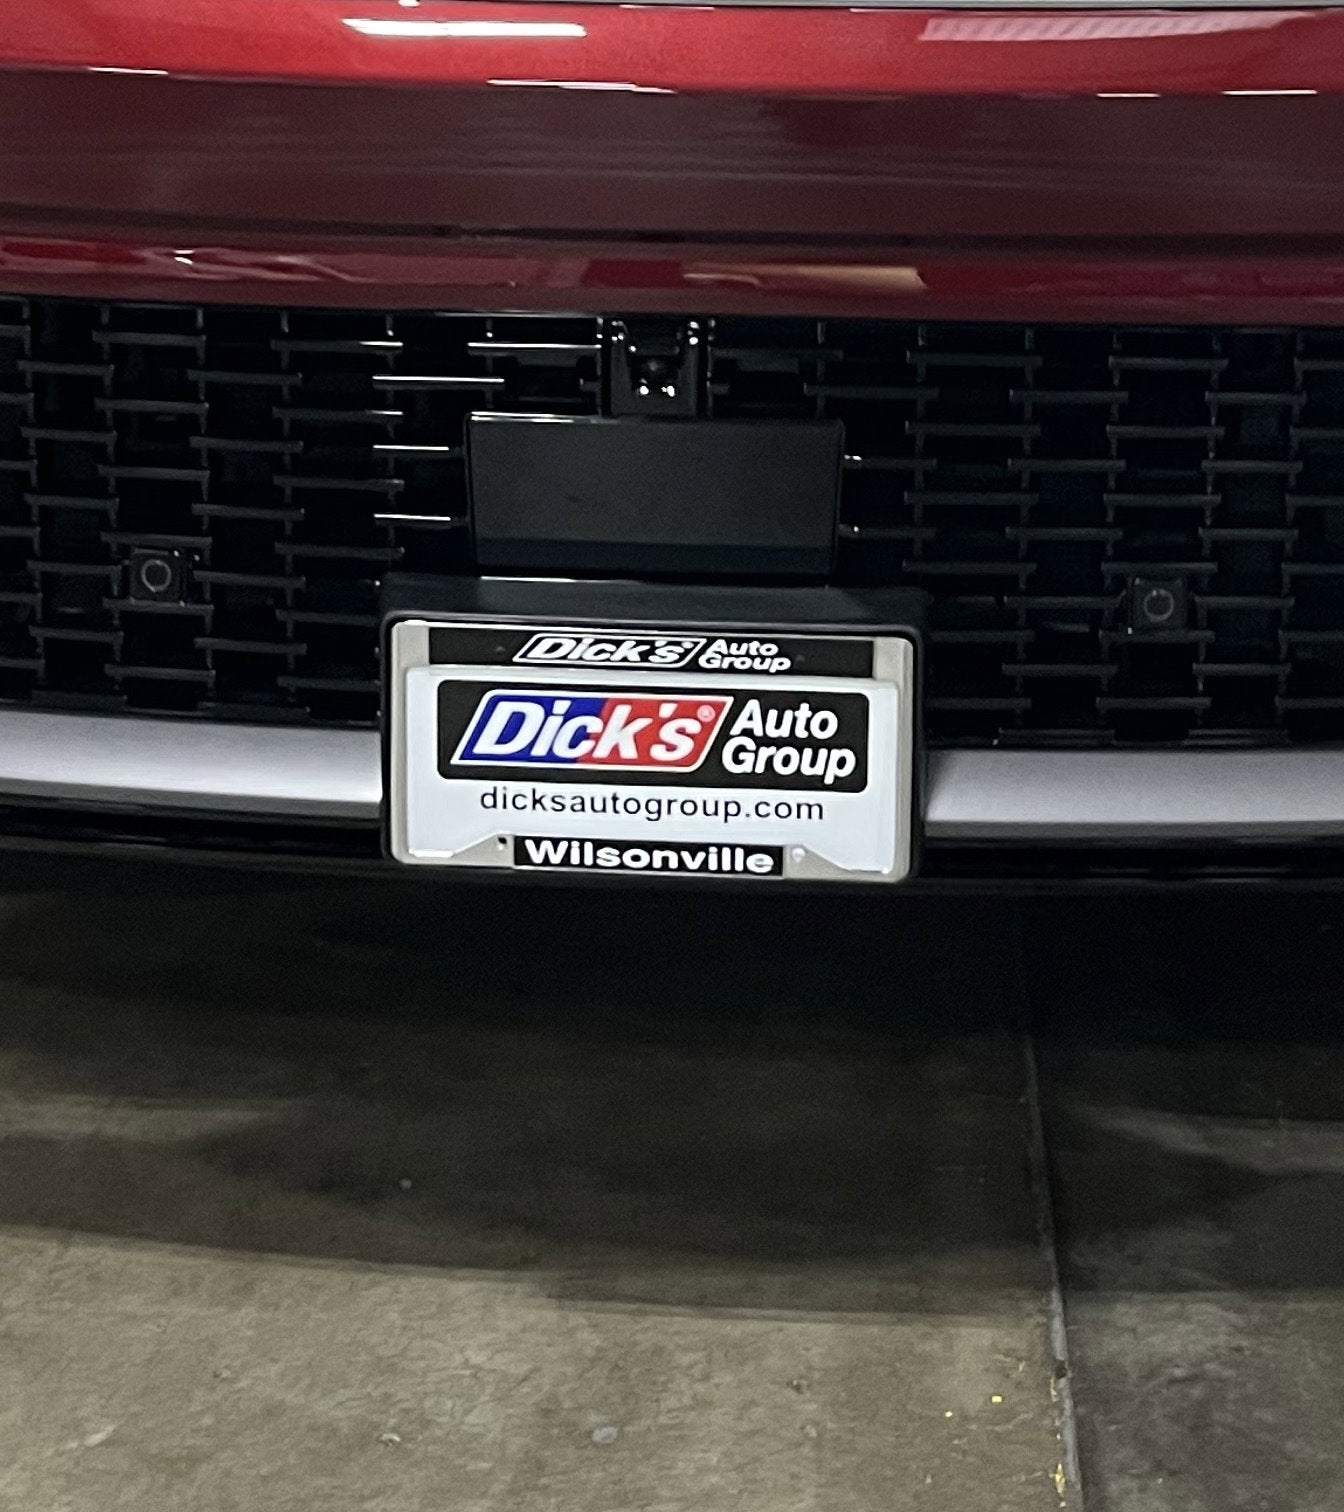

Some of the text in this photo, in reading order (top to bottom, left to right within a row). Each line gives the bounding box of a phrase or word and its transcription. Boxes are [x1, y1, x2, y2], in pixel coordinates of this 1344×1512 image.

[528, 636, 692, 664] Dick's
[698, 654, 792, 673] Group
[705, 639, 779, 657] Auto
[472, 697, 701, 762] Dick's
[729, 699, 839, 740] Auto
[721, 738, 856, 785] Group
[479, 786, 825, 824] dicksautogroup.com
[524, 838, 775, 874] Wilsonville
